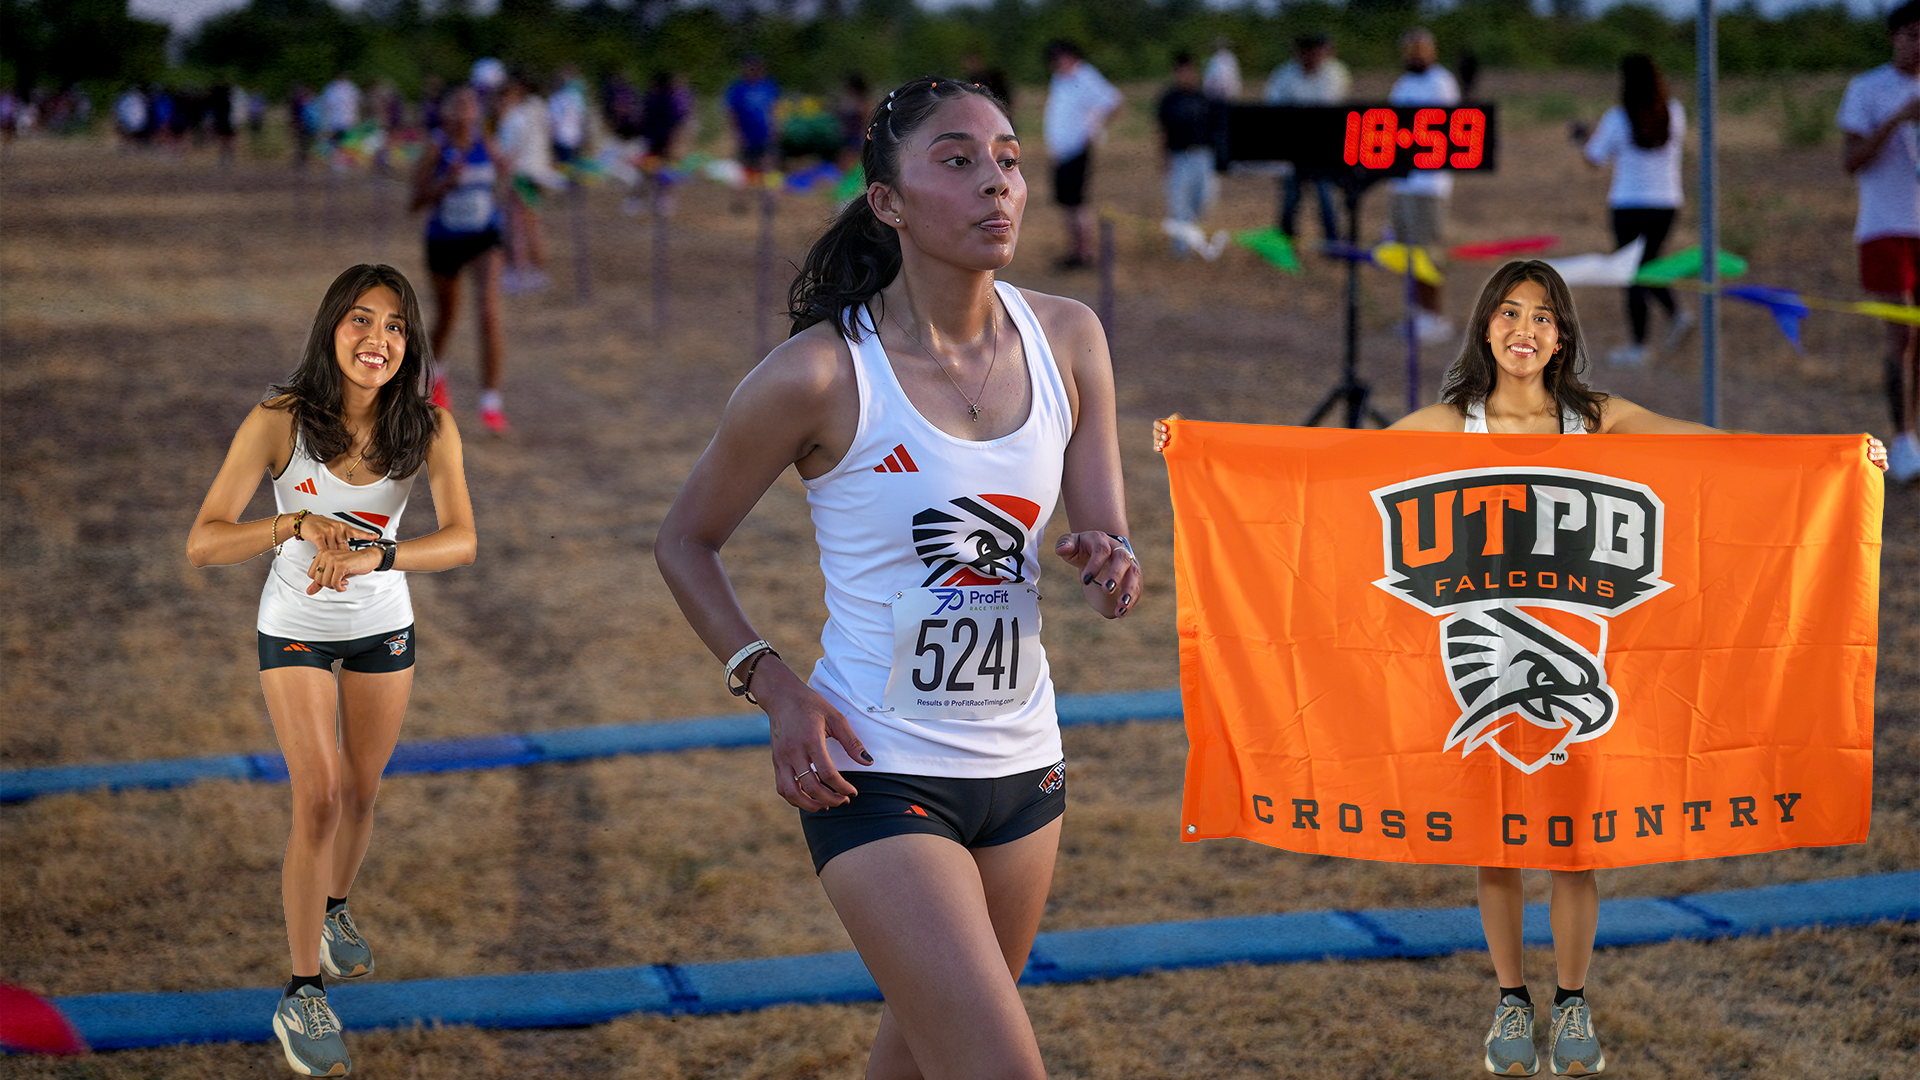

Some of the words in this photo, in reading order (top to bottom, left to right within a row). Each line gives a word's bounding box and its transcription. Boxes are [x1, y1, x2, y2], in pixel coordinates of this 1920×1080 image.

[1395, 484, 1646, 571] UTPB
[969, 590, 1009, 604] ProFit
[1434, 571, 1615, 598] FALCONS
[911, 617, 1020, 692] 5241
[916, 698, 943, 707] Results
[951, 698, 1014, 707] ProFitRaceTiming.com
[1550, 752, 1565, 761] TM
[1252, 794, 1453, 842] CROSS
[1502, 793, 1801, 847] COUNTRY
